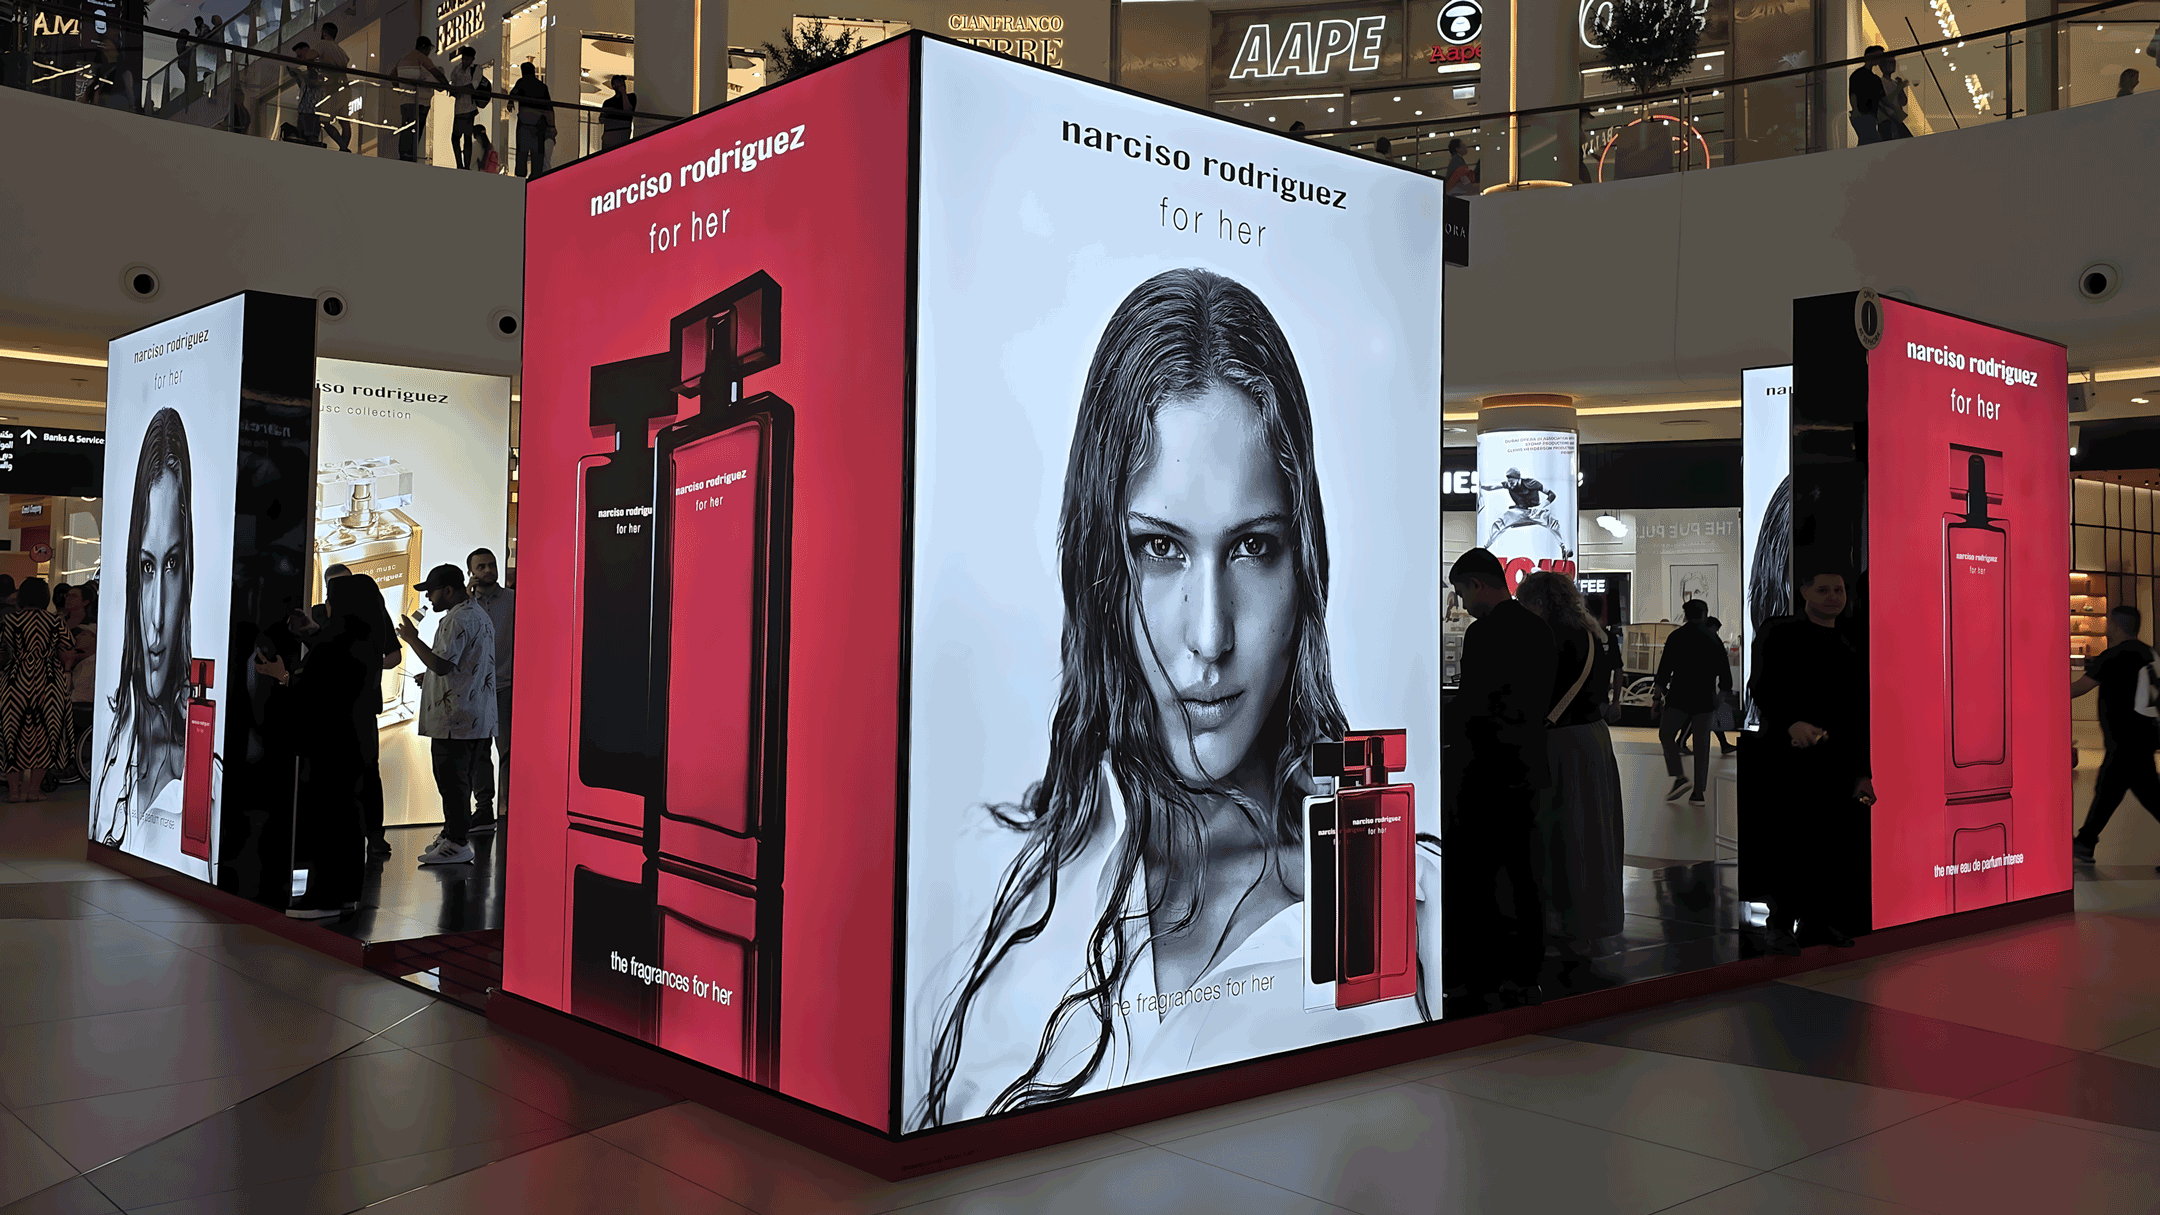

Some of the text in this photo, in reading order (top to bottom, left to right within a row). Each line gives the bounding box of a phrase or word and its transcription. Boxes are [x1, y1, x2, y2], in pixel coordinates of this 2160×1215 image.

[948, 14, 1064, 32] GIANFRANCO
[1229, 15, 1387, 79] AAPE
[590, 124, 805, 217] narciso rodriguez
[1061, 120, 1348, 210] narciso rodriguez
[649, 207, 731, 254] for her
[1160, 196, 1267, 247] for her
[1445, 222, 1466, 239] ORA
[133, 329, 210, 364] narciso rodriguez
[1906, 341, 2039, 388] narciso rodriguez
[154, 369, 184, 391] for her
[352, 383, 449, 404] rodriguez
[1950, 387, 2001, 421] for her
[347, 405, 412, 420] collection
[43, 433, 105, 444] Banks & Service
[675, 469, 748, 496] narciso rodriguez
[597, 506, 653, 518] narciso rodrigu
[695, 496, 724, 512] for her
[616, 523, 642, 535] for her
[375, 572, 403, 583] driguez
[1578, 579, 1606, 593] FEE
[1934, 853, 2024, 878] the new eau de parfum intense
[610, 950, 733, 1006] the fragrances for her
[1136, 984, 1221, 1014] fragrances
[1225, 977, 1247, 998] for
[1251, 974, 1276, 993] her
